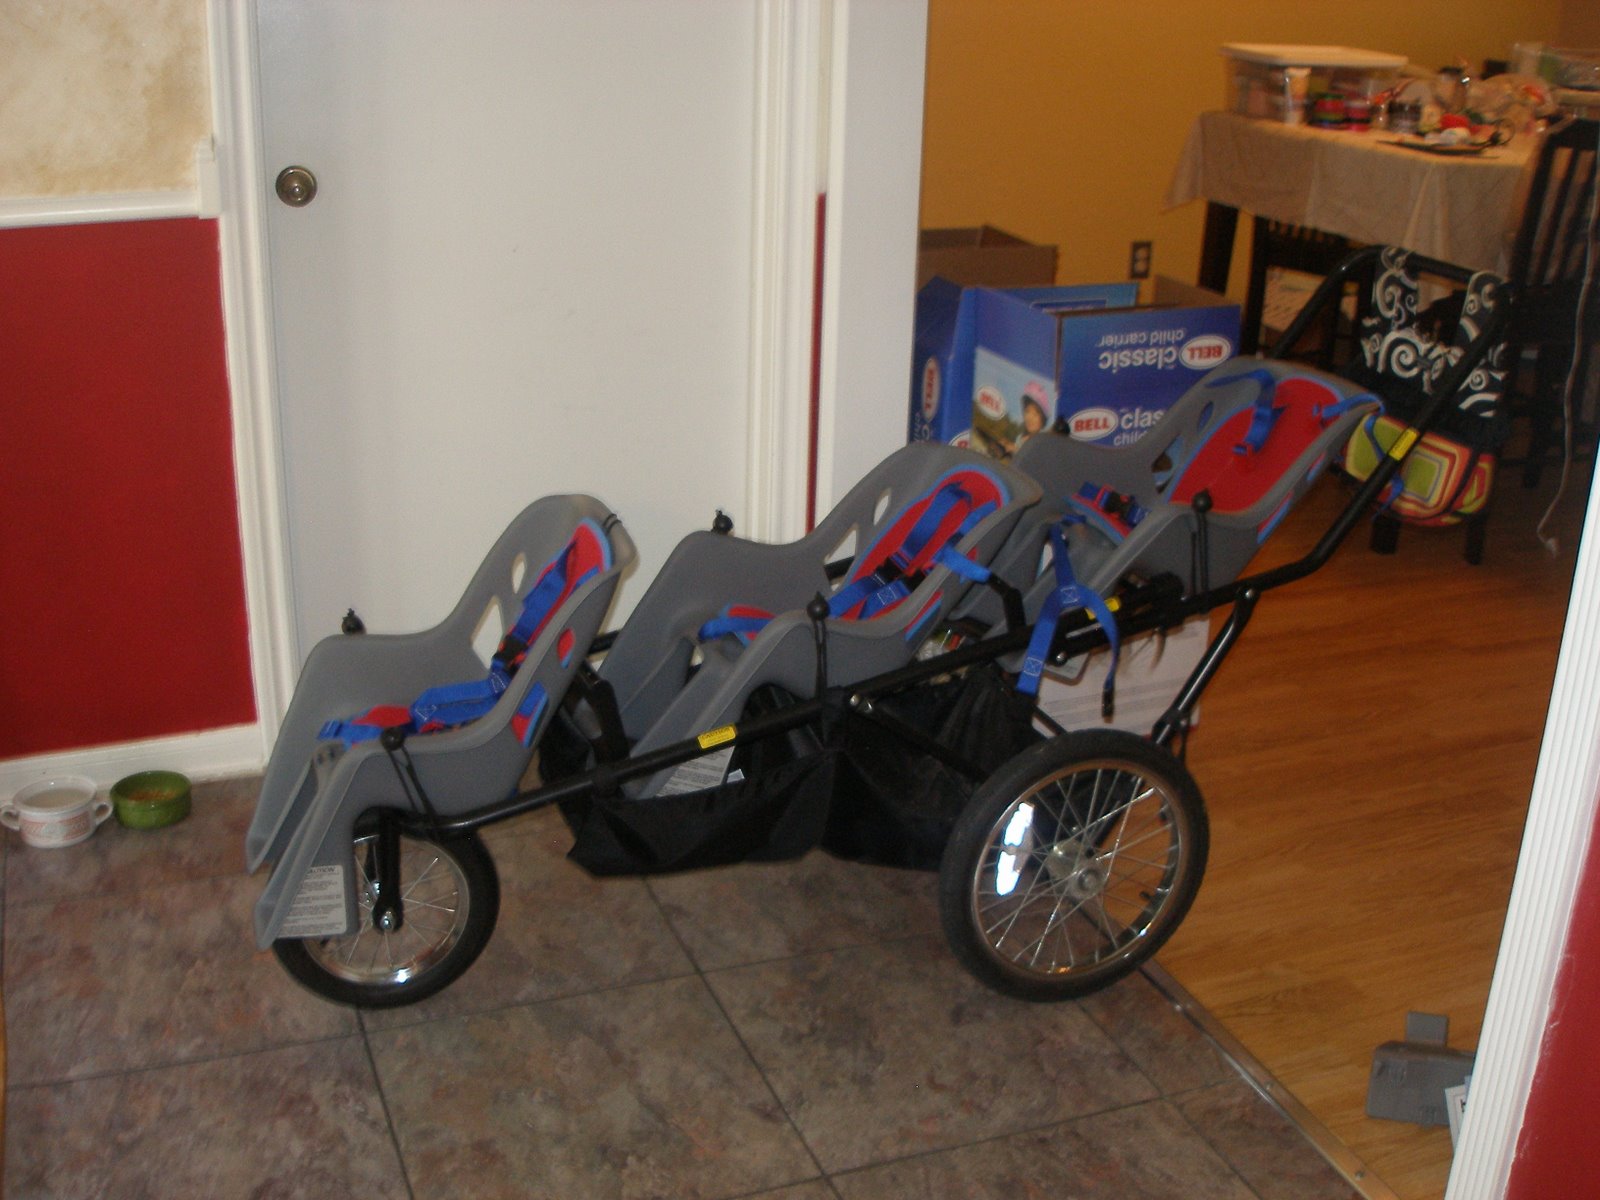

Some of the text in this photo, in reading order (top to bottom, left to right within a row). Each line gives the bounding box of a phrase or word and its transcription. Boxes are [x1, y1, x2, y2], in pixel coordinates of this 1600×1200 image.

[1100, 328, 1184, 347] child carrier
[1099, 345, 1222, 373] BELL classic
[1074, 407, 1164, 432] BELL clas
